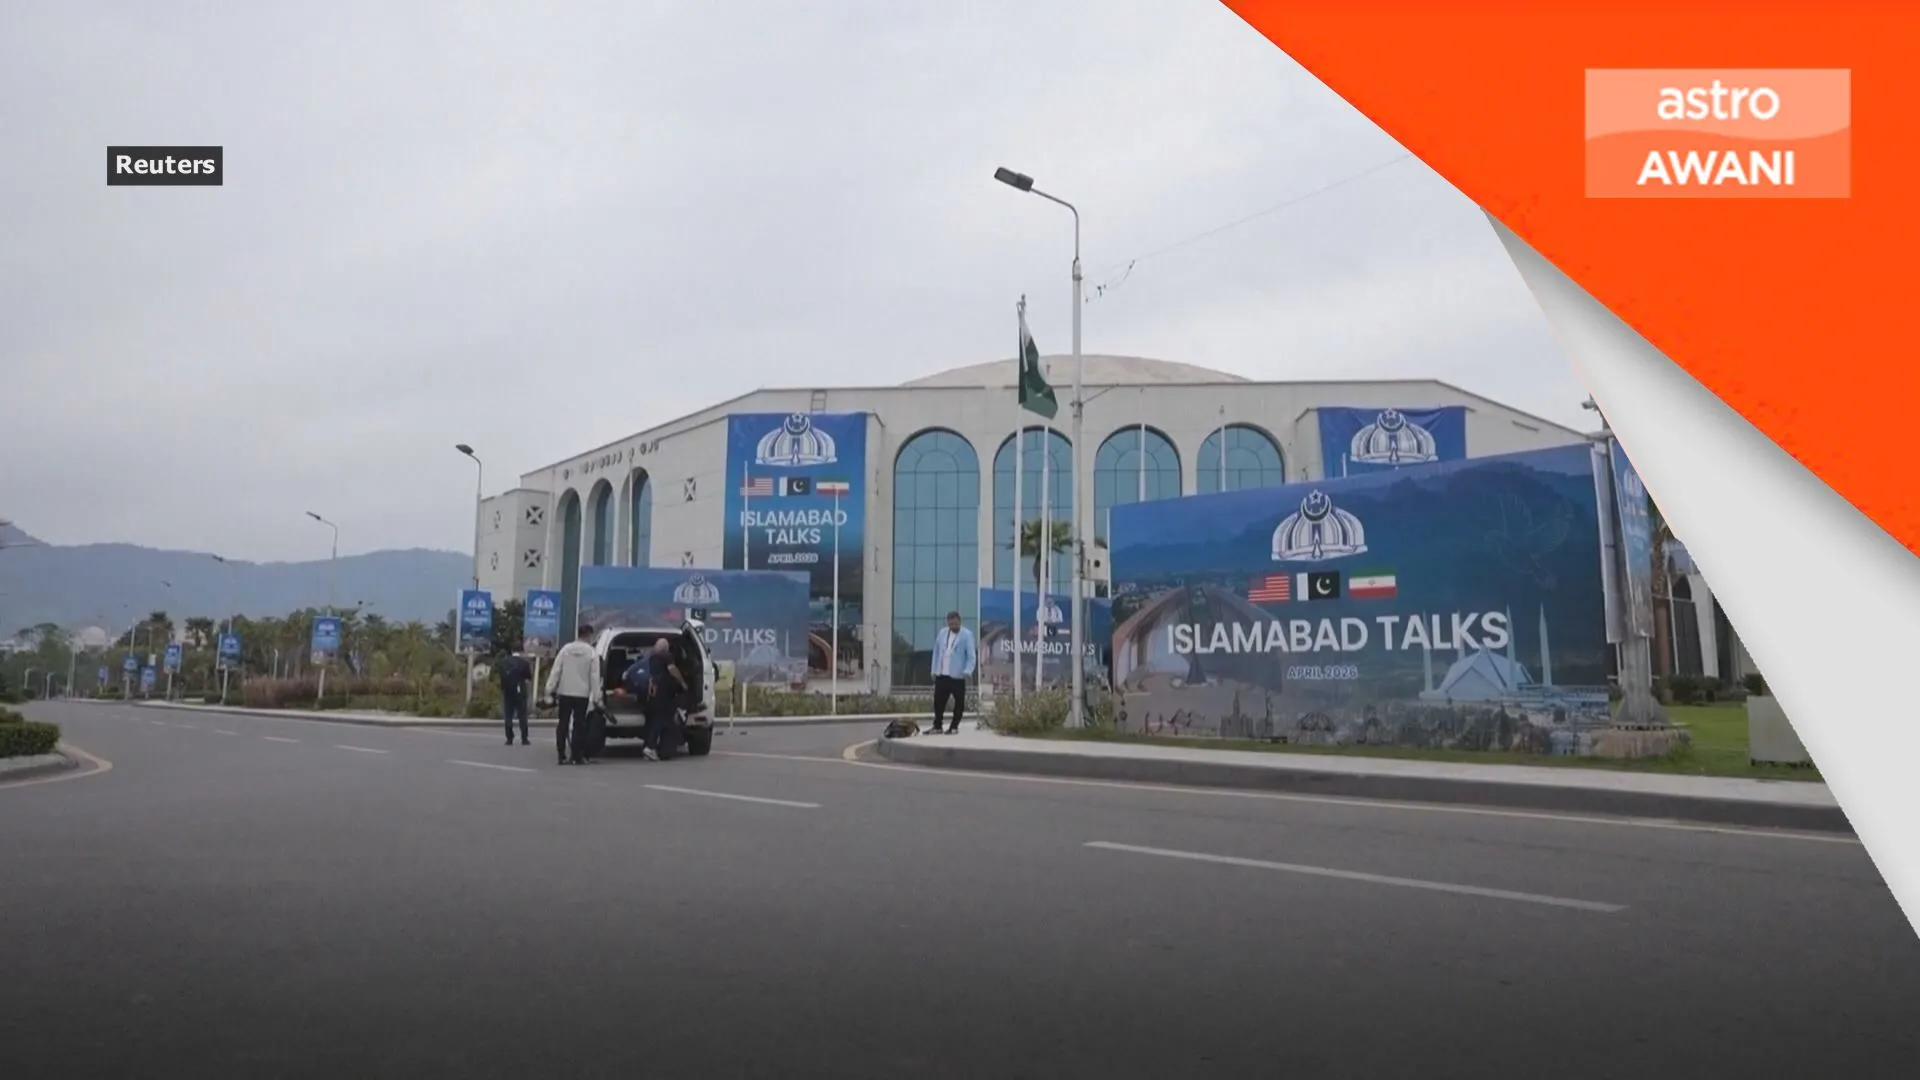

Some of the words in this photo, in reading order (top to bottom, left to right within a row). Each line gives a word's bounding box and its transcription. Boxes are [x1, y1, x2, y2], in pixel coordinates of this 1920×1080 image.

[740, 509, 848, 527] ISLAMABAD
[765, 528, 821, 545] TALKS
[721, 628, 776, 644] TALKS
[1167, 616, 1368, 654] ISLAMABAD
[1376, 611, 1508, 650] TALKS
[1286, 665, 1323, 680] APRIL
[1324, 664, 1358, 679] 2026
